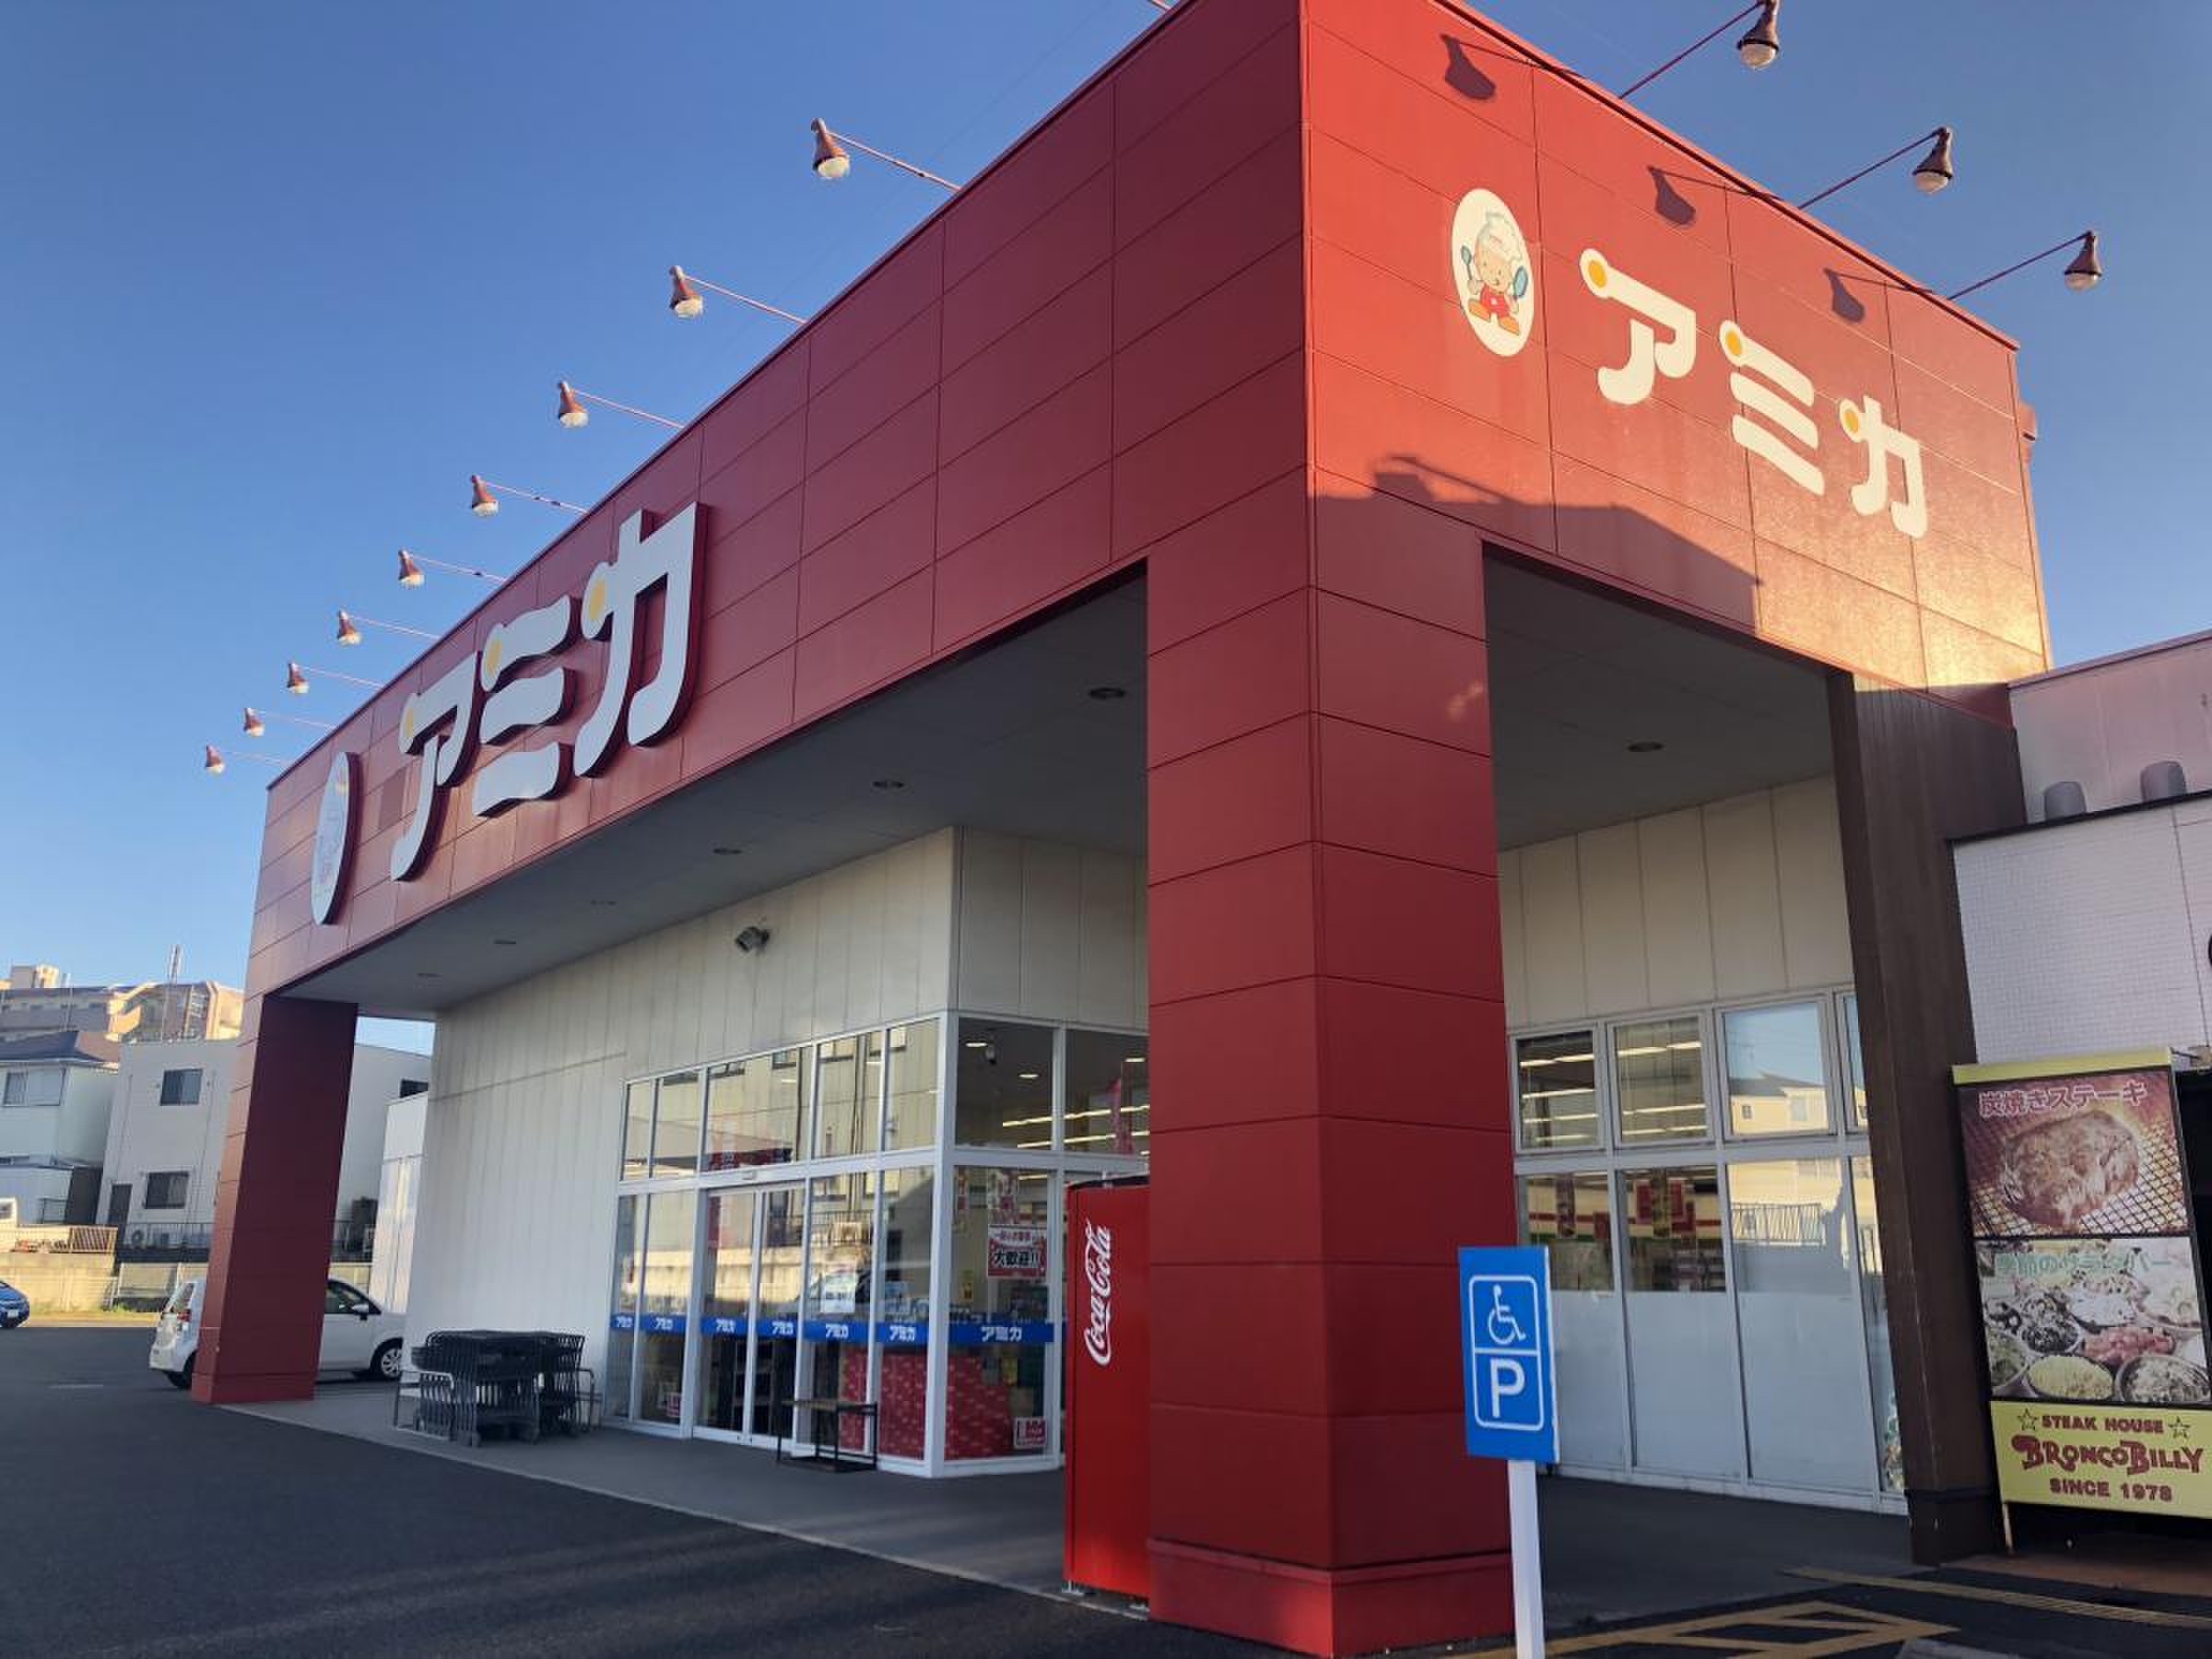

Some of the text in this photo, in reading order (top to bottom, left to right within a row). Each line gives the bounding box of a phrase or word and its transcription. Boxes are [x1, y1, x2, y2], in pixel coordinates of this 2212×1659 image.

[1580, 249, 1927, 539] アミカ
[391, 501, 707, 881] アミカ
[981, 1325, 1023, 1343] アミカ
[1489, 1358, 1525, 1418] P
[2041, 1415, 2164, 1434] STEAK HOUSE
[2050, 1477, 2173, 1501] SINCE 1978
